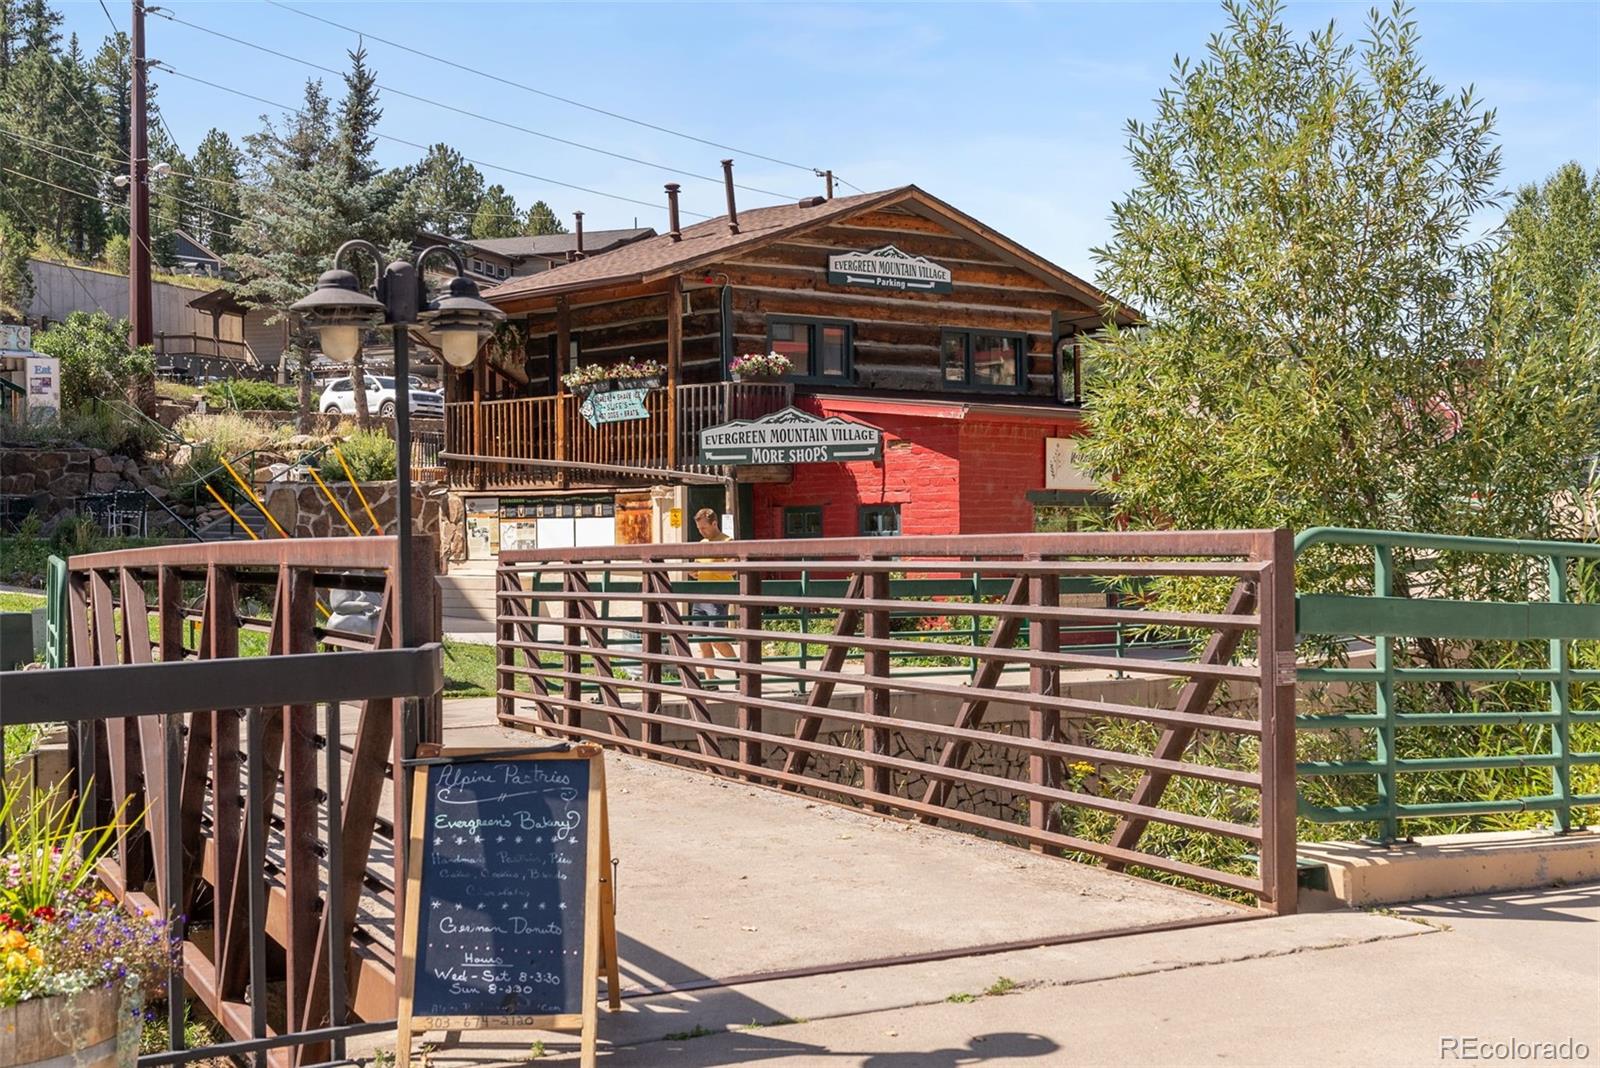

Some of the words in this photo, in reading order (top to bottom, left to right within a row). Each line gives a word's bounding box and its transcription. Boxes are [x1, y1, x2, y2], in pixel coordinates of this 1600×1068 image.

[834, 260, 877, 273] EVERGREEN
[878, 261, 917, 277] MOUNTAIN
[918, 266, 947, 280] VILLAGE
[876, 277, 906, 289] Parking
[705, 430, 766, 446] EVERGREEN
[770, 428, 828, 443] MOUNTAIN
[829, 430, 875, 442] VILLAGE
[751, 447, 785, 464] MORE
[789, 446, 828, 462] SHOPS
[439, 916, 508, 935] German
[508, 916, 563, 935] Donuts
[464, 952, 503, 965] Hours
[449, 983, 480, 995] Sun
